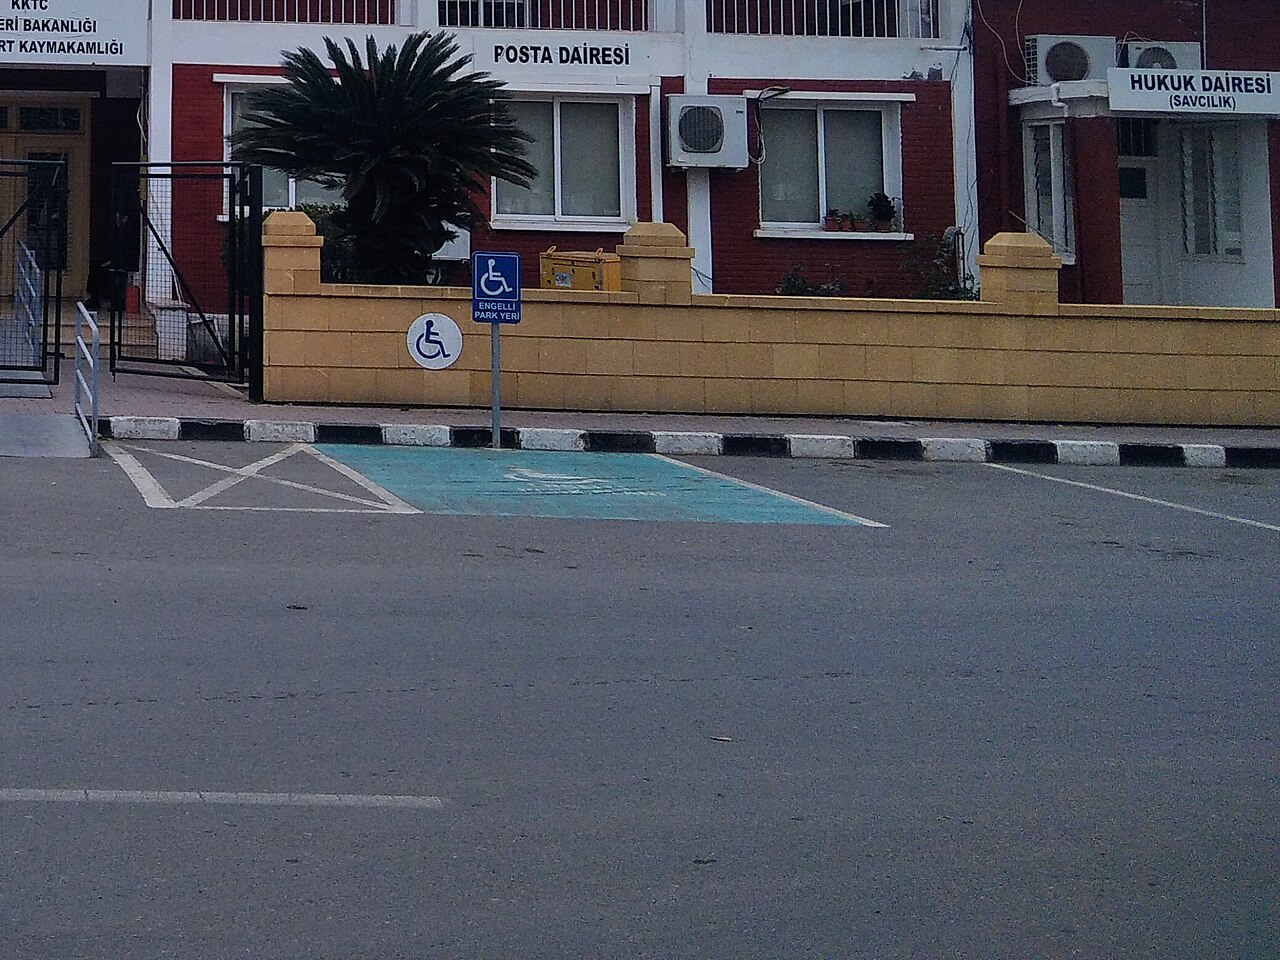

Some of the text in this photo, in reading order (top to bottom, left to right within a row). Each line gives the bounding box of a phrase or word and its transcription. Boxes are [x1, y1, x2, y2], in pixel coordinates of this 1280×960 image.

[23, 18, 97, 33] BAKANLIĞI
[19, 39, 124, 56] KAYMAKAMLIĞI
[494, 42, 630, 65] POSTA DAİRESİ
[1130, 72, 1272, 94] HUKUK DAİRESİ
[1169, 94, 1237, 111] (SAVCILIK)
[474, 311, 499, 320] PARK
